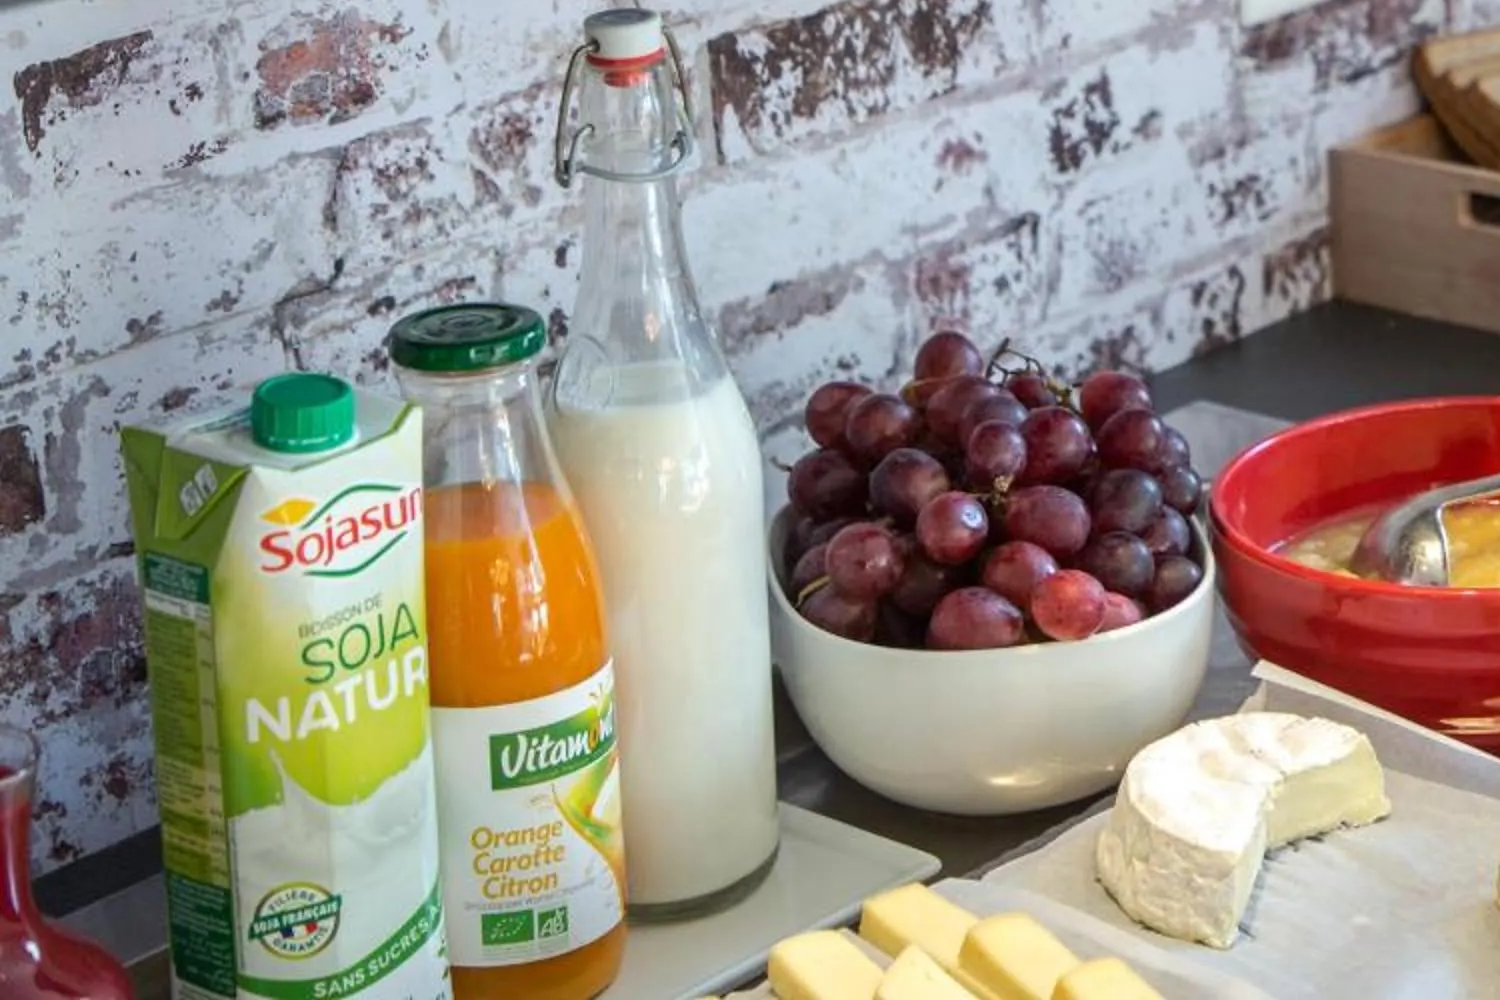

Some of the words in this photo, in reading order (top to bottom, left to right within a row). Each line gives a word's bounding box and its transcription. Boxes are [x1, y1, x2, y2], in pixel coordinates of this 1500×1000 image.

[258, 486, 422, 573] Sojasun
[301, 602, 419, 685] SOJA
[471, 820, 563, 849] Orange
[473, 844, 565, 875] Carotte
[481, 872, 559, 900] Citron
[314, 968, 365, 999] SANS
[367, 917, 429, 976] SUCRES
